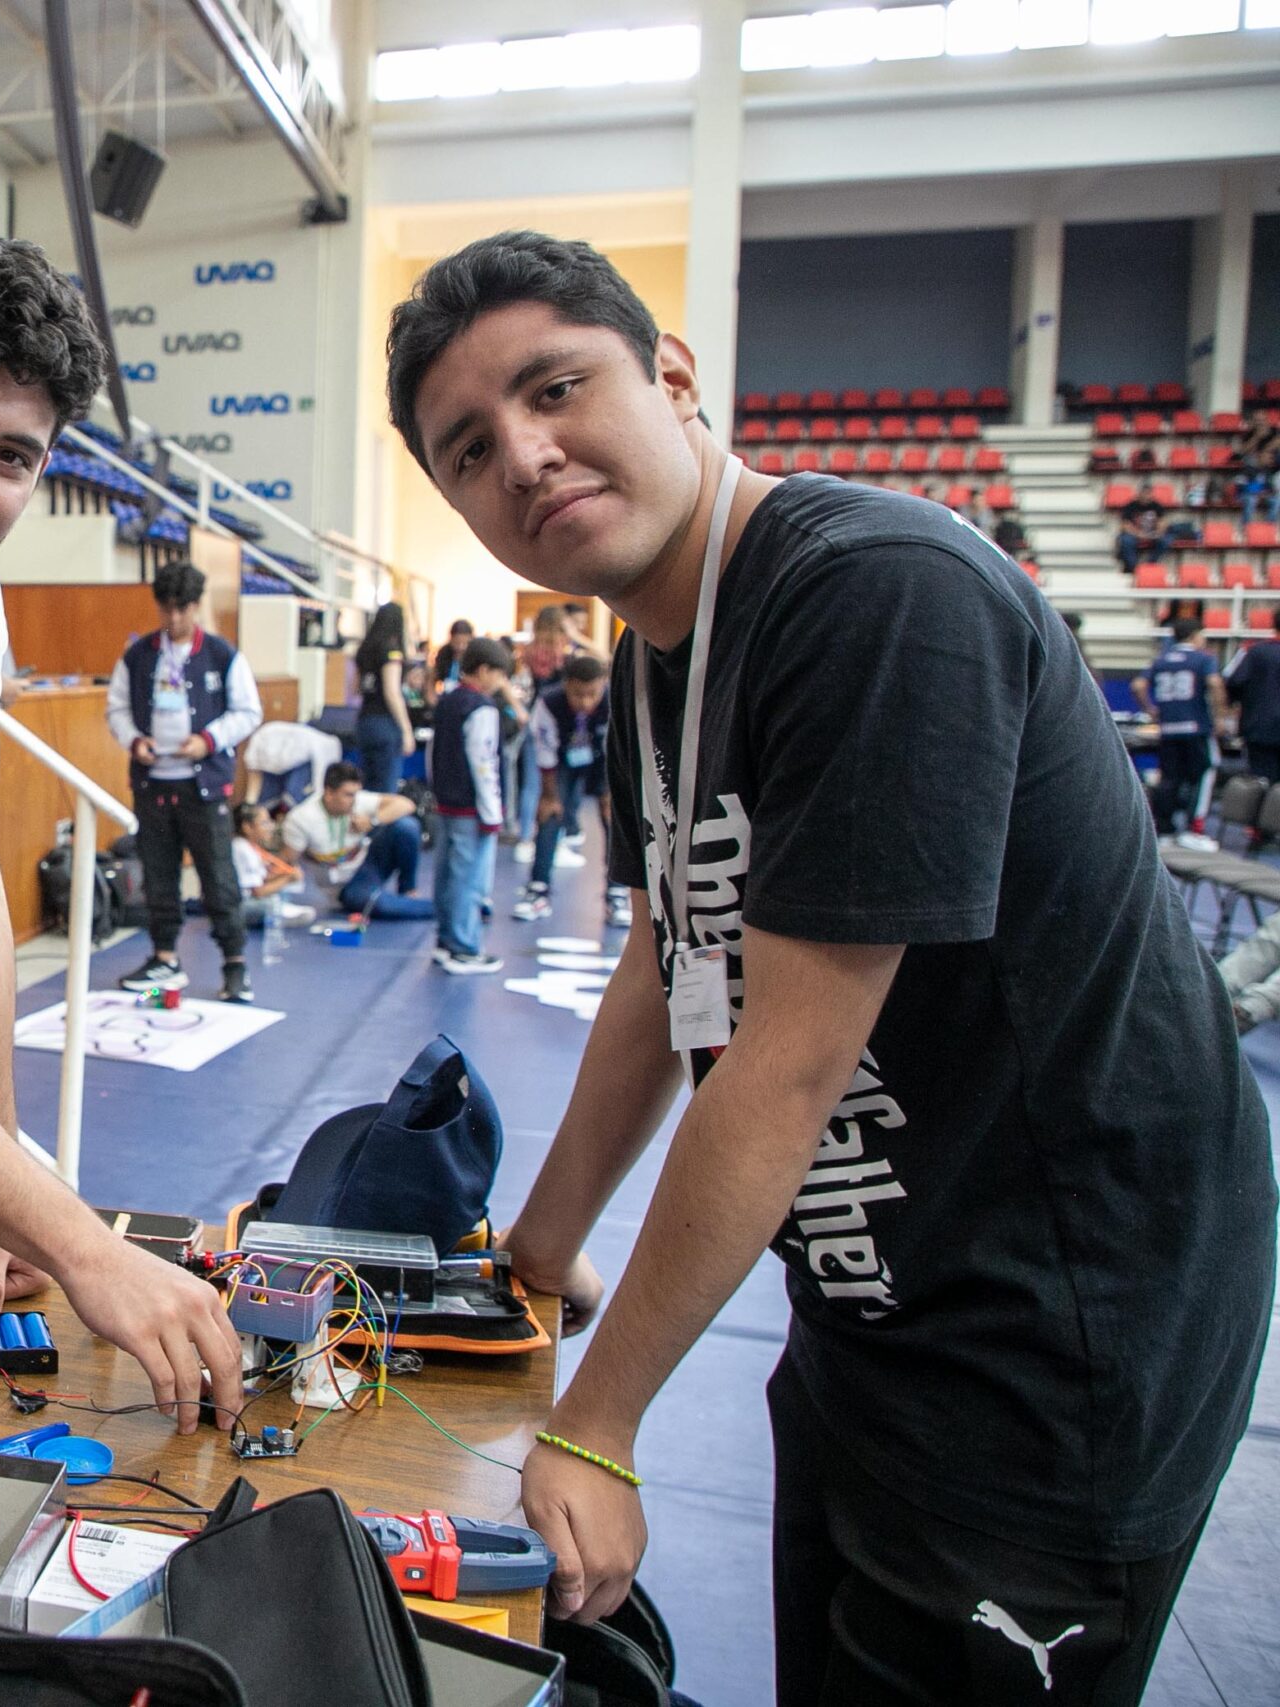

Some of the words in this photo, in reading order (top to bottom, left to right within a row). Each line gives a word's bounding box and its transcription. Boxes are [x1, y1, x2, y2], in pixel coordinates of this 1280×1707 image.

[195, 261, 276, 285] UVAQ
[163, 331, 241, 354] UVAQ
[210, 394, 290, 416] UVAQ
